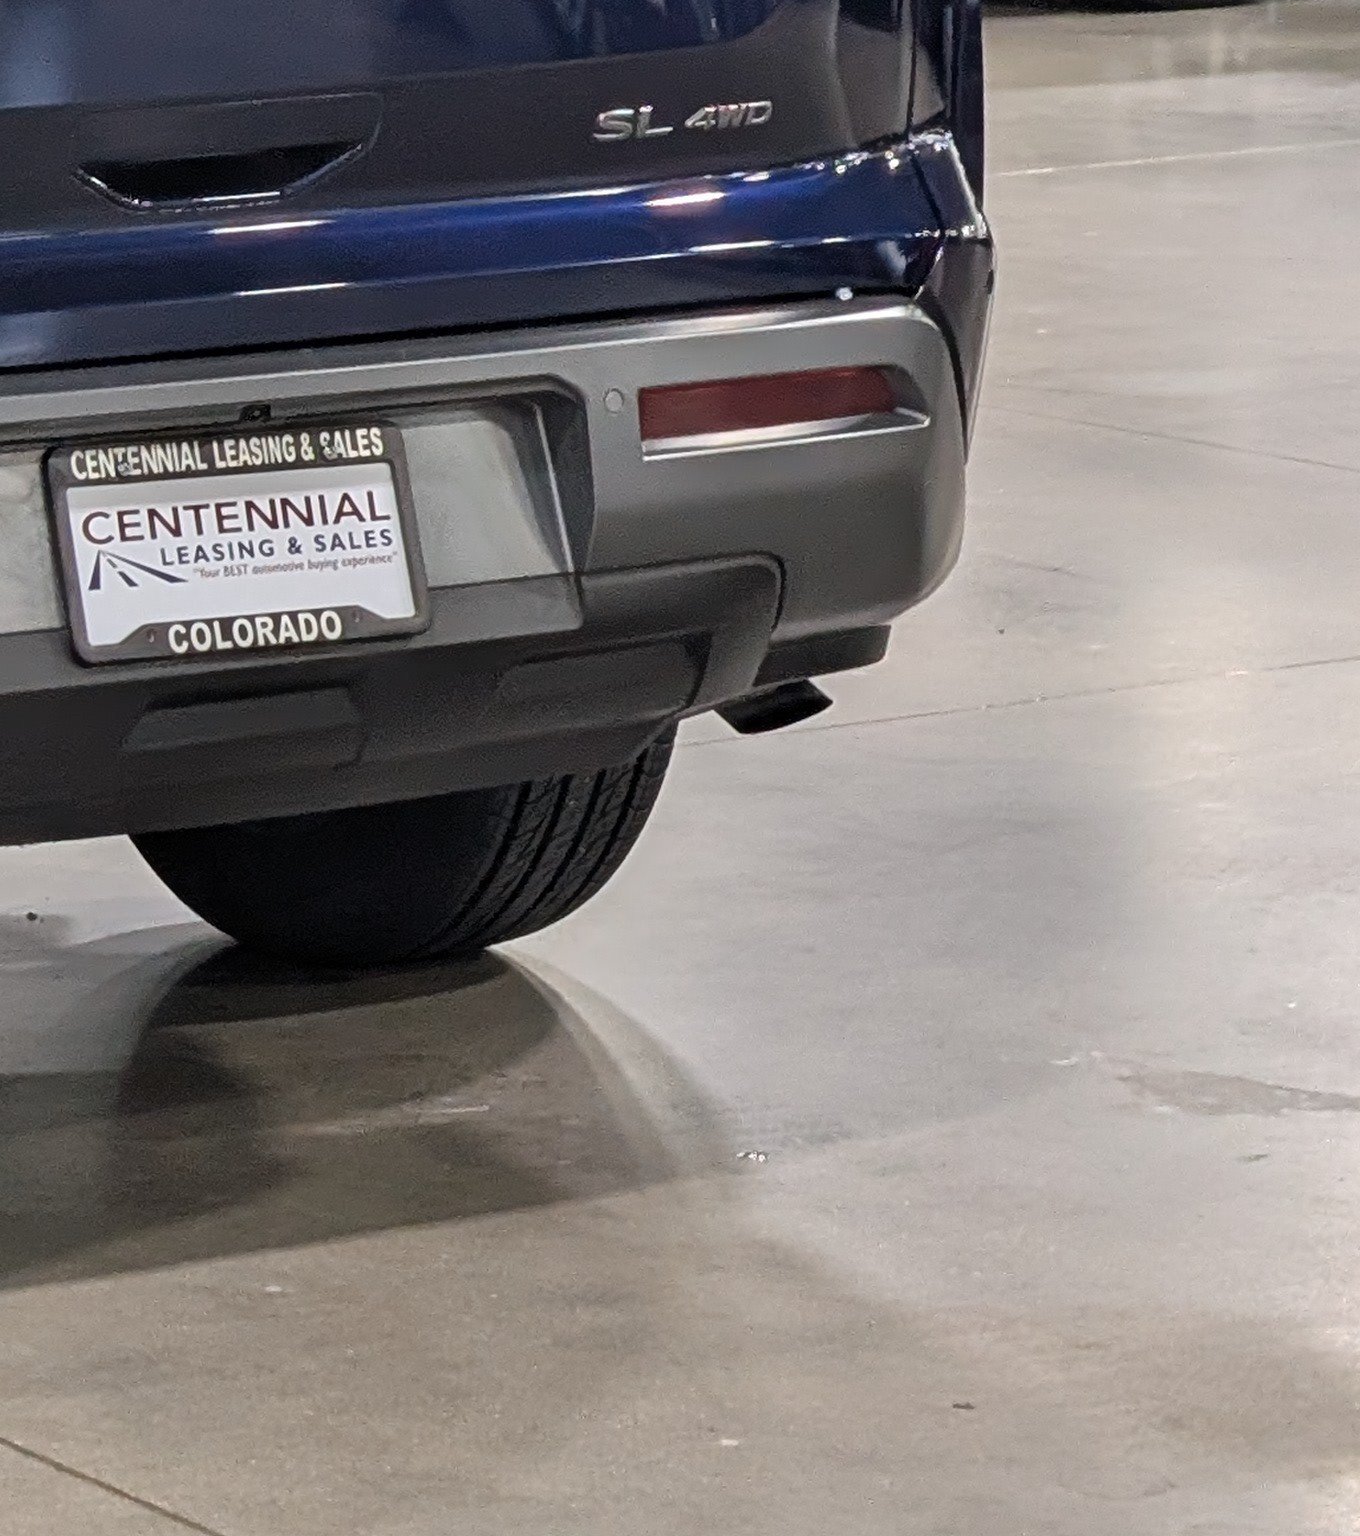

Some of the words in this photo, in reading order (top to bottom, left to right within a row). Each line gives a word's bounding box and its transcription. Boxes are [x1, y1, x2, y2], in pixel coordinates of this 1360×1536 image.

[593, 104, 673, 142] SL
[684, 100, 772, 129] 4WD
[71, 442, 208, 481] CENTENNIAL
[212, 434, 295, 470] LEASING
[300, 434, 315, 462] &
[319, 427, 383, 460] SALES
[81, 490, 391, 545] CENTENNIAL
[160, 539, 275, 566] LEASING
[287, 536, 303, 555] &
[314, 529, 393, 553] SALES
[223, 565, 248, 578] BEST
[307, 557, 339, 571] buying
[168, 610, 342, 654] COLORADO
